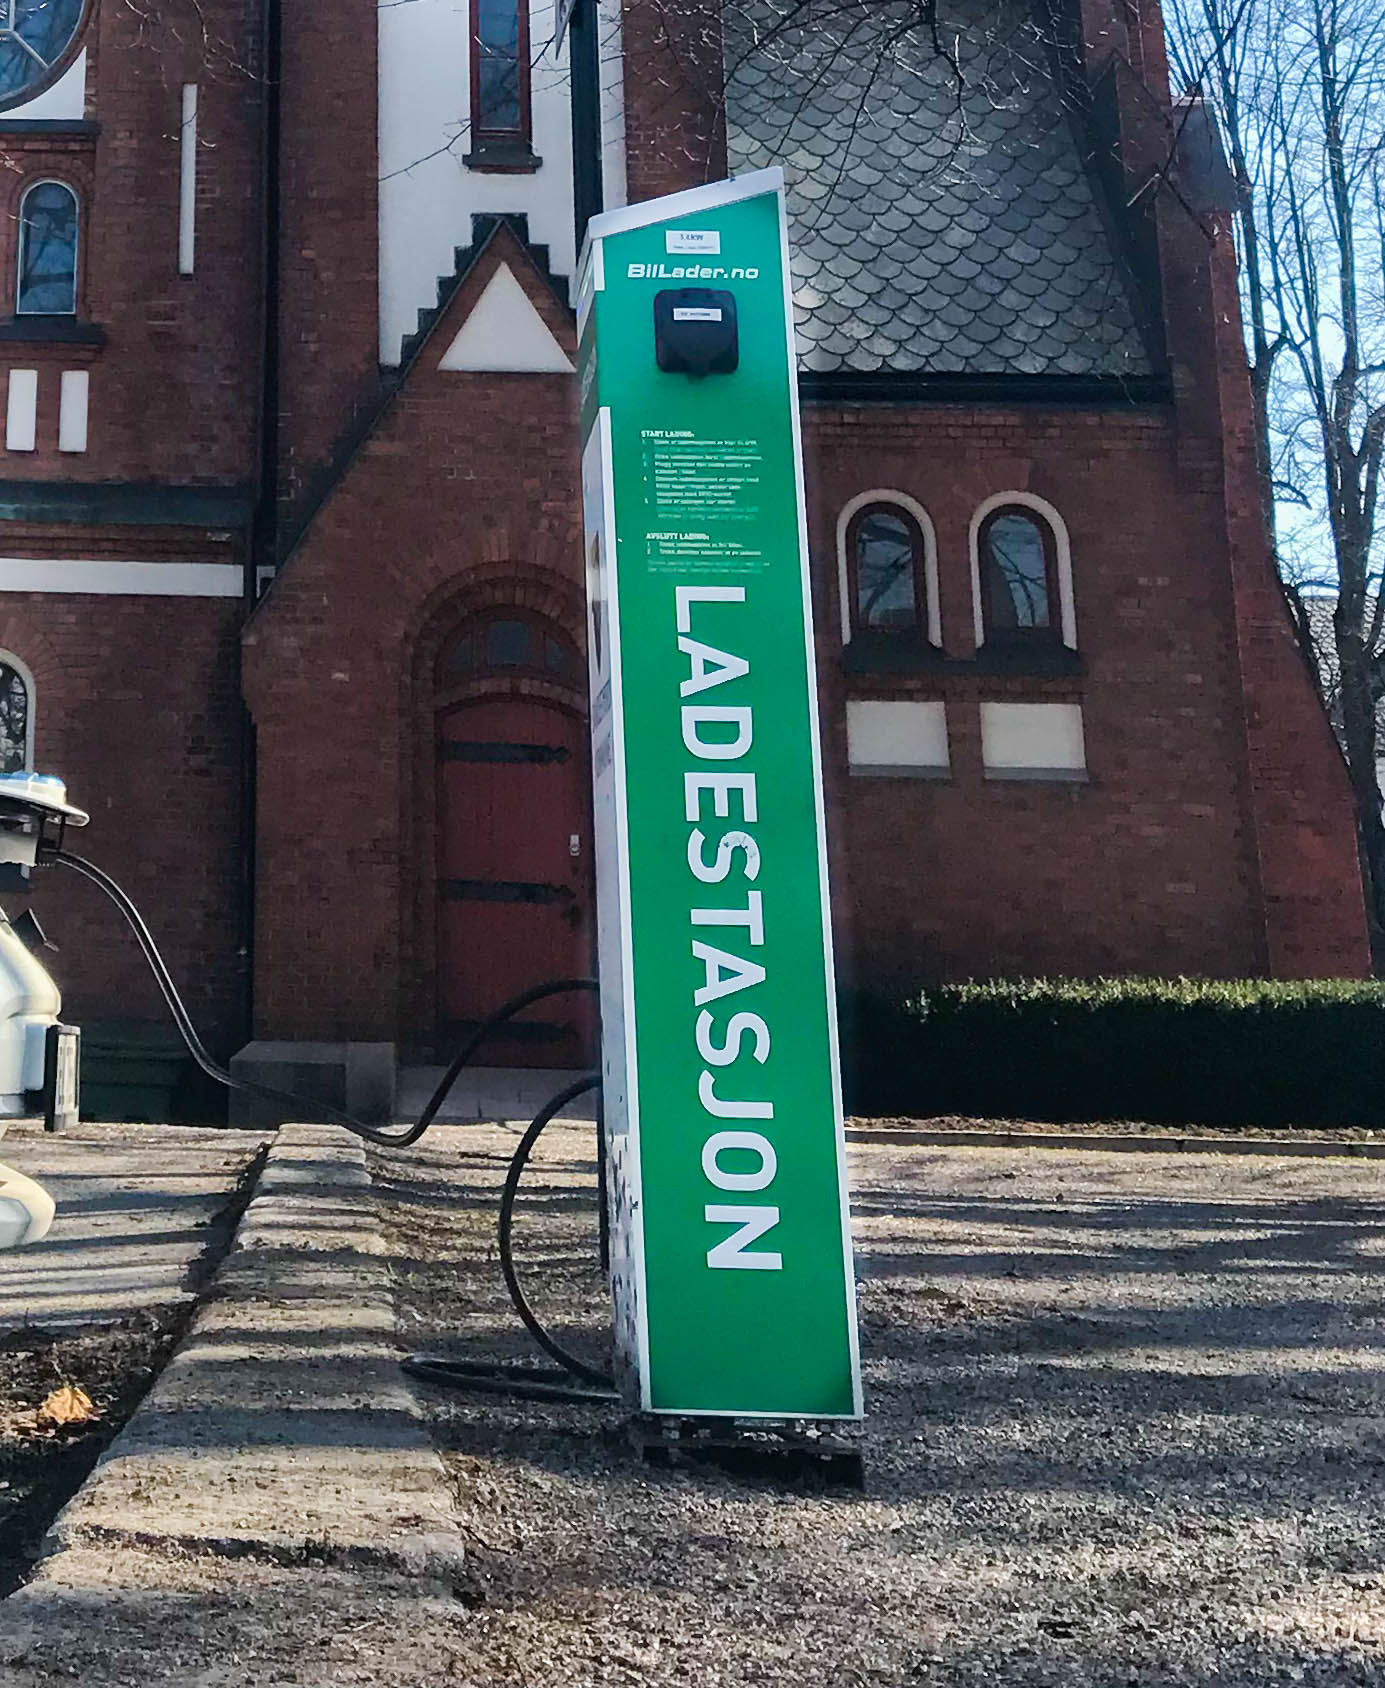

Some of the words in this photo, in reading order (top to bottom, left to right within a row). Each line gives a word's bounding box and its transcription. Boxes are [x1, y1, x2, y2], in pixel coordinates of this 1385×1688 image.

[627, 263, 759, 279] BilLader.no
[641, 430, 664, 438] START
[675, 586, 783, 1270] LADESTASJON
